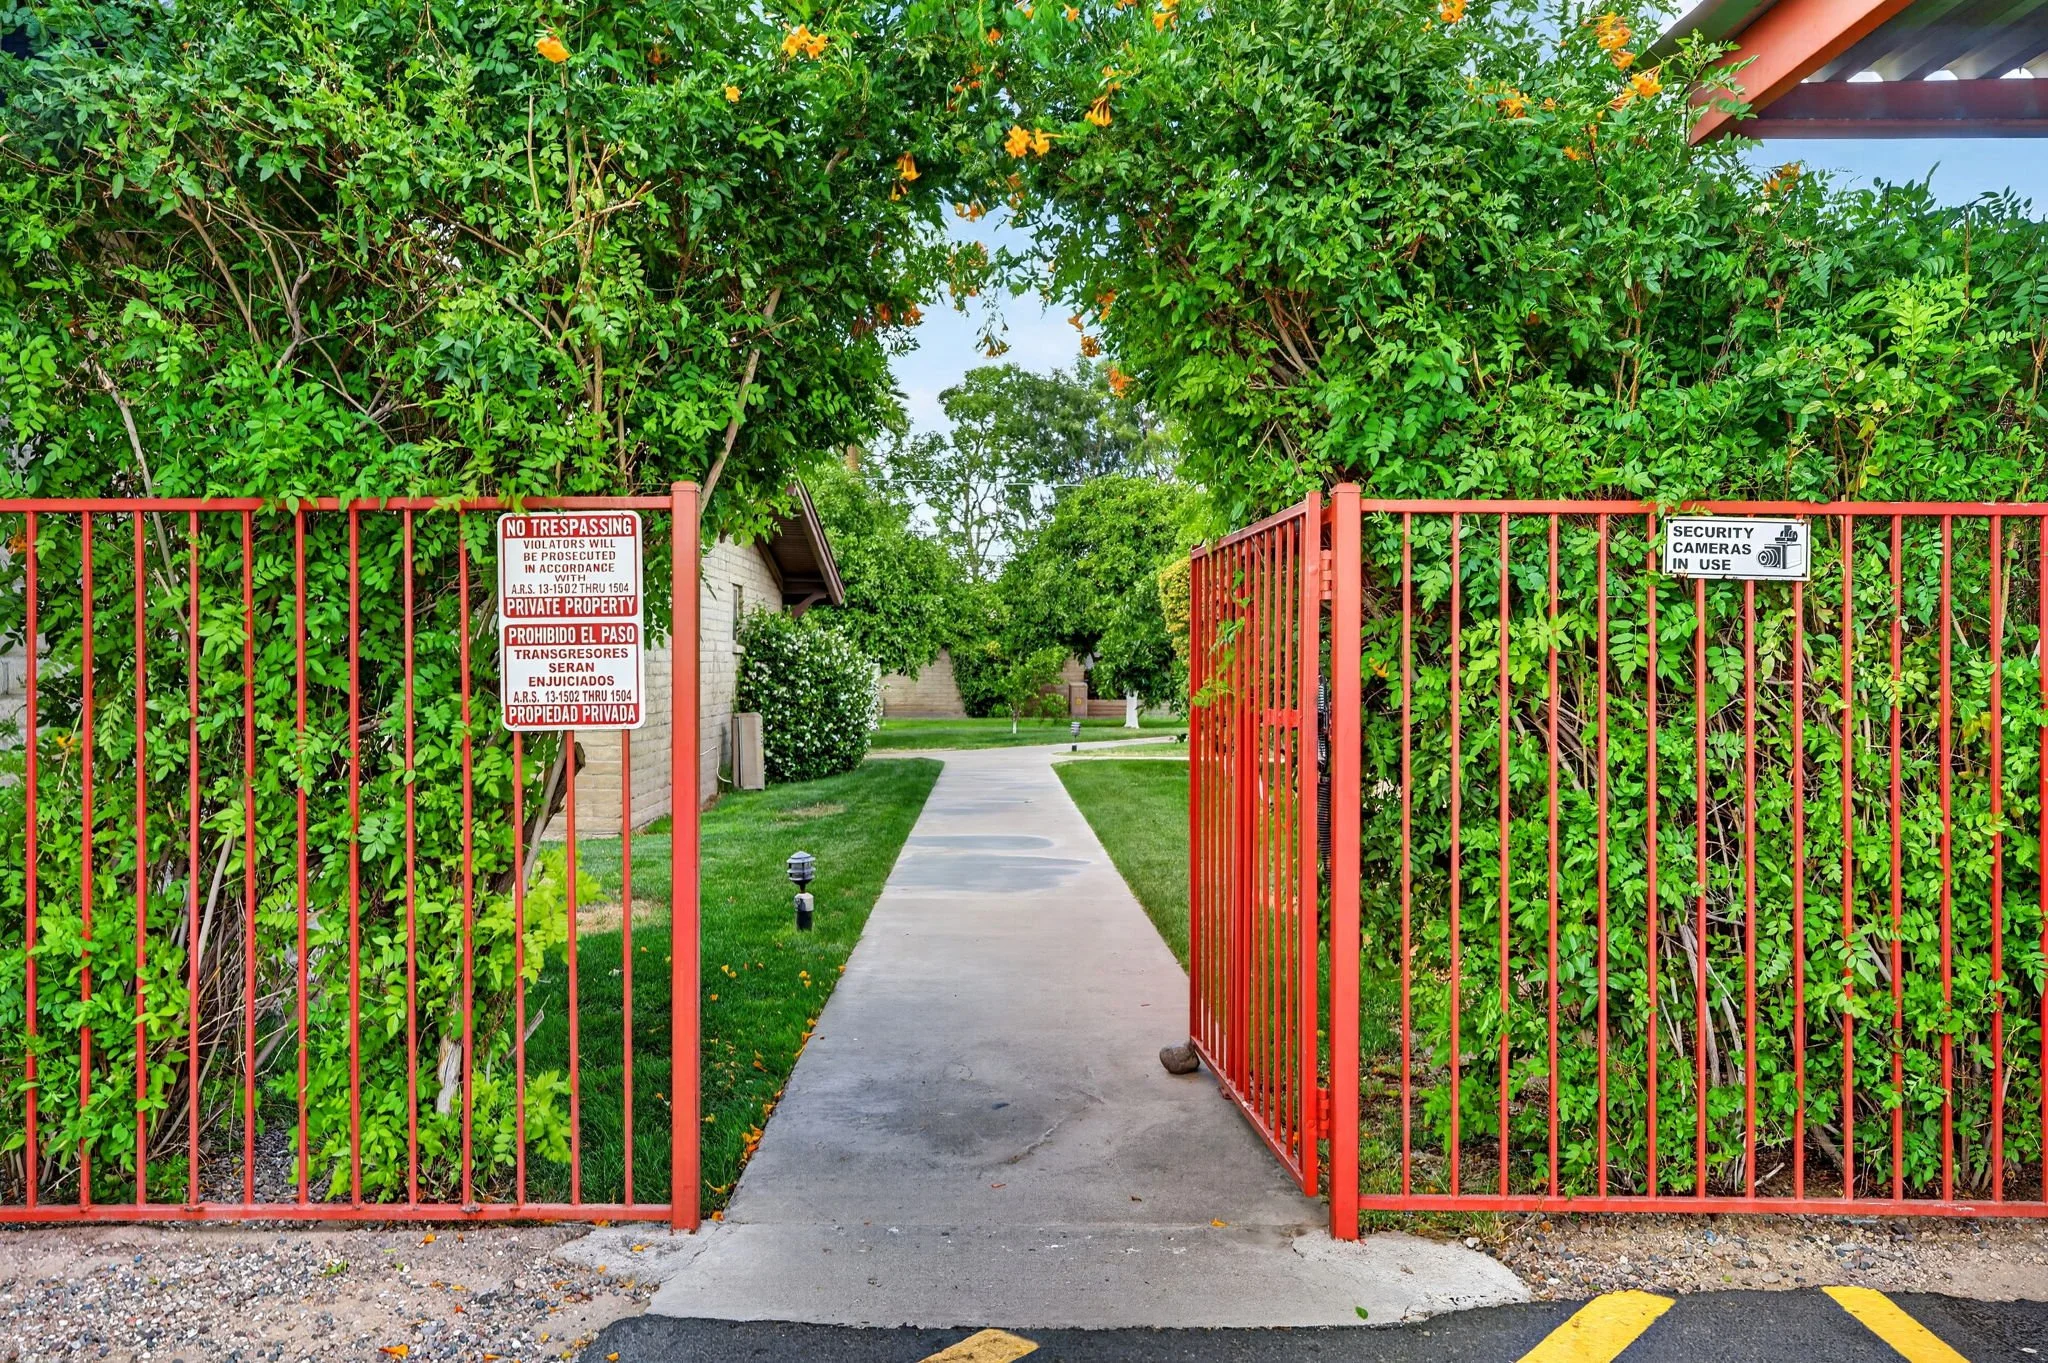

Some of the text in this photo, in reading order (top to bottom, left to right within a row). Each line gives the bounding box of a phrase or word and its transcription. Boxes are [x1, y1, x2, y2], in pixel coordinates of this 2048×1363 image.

[506, 518, 632, 536] NO TRESPASSING
[1673, 526, 1754, 539] SECURITY
[523, 539, 615, 550] VIOLATORS WILL
[1673, 542, 1751, 554] CAMERAS
[524, 551, 615, 561] BE PROSECUTED
[525, 563, 615, 573] IN ACCORDANCE
[1673, 558, 1731, 570] IN USE
[512, 583, 629, 594] A.R.S. 13-1502 THRU 1504
[507, 596, 635, 616] PRIVATE PROPERTY
[509, 626, 634, 644] PROHIBIDO EL PASO
[514, 648, 628, 659] TRANSGRESORES
[549, 663, 594, 673] SERAN
[529, 676, 614, 687] ENJUICIADOS
[513, 690, 631, 703] A.R.S. 13-1502 THRU 1504
[509, 705, 636, 723] PROPIEDAD PRIVADA
